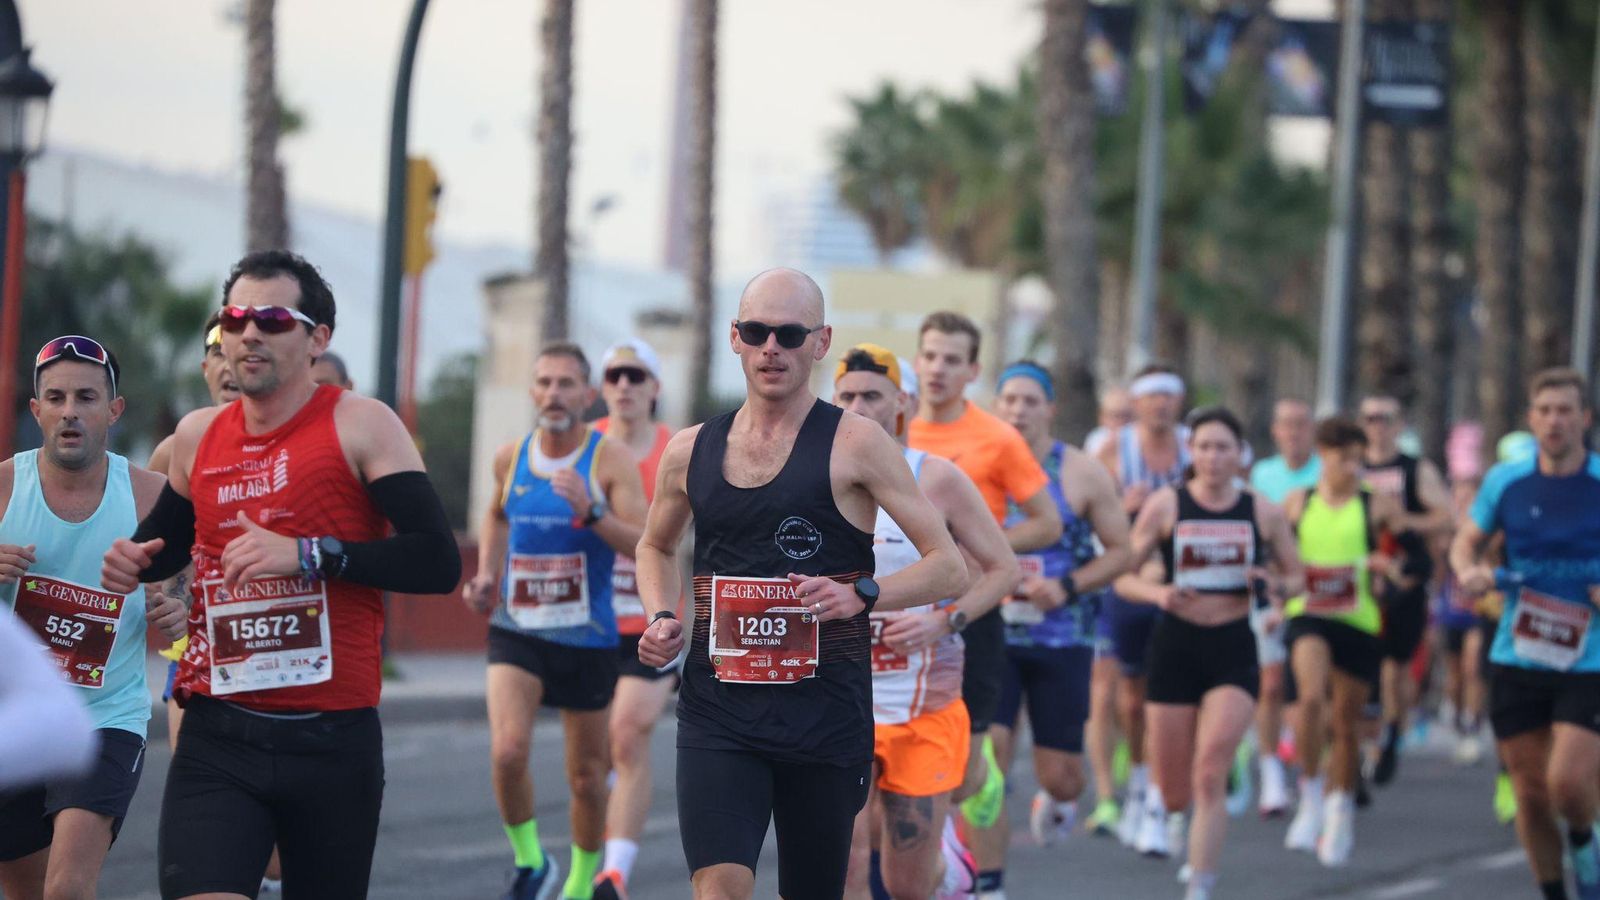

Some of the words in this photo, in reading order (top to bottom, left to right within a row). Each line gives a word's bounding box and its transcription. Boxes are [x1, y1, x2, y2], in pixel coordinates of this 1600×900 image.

[217, 476, 272, 505] MÁLAGA
[782, 520, 802, 533] RUNNING
[802, 523, 814, 533] CLUB
[788, 549, 799, 557] EST.
[737, 584, 802, 600] GENERA
[45, 615, 86, 641] 552
[229, 614, 301, 641] 15672
[737, 616, 788, 636] 1203
[50, 636, 74, 648] MANU
[245, 638, 282, 649] ALBERTO
[740, 637, 781, 646] SEBASTIAN
[75, 663, 92, 671] 42K
[780, 659, 801, 667] 42K
